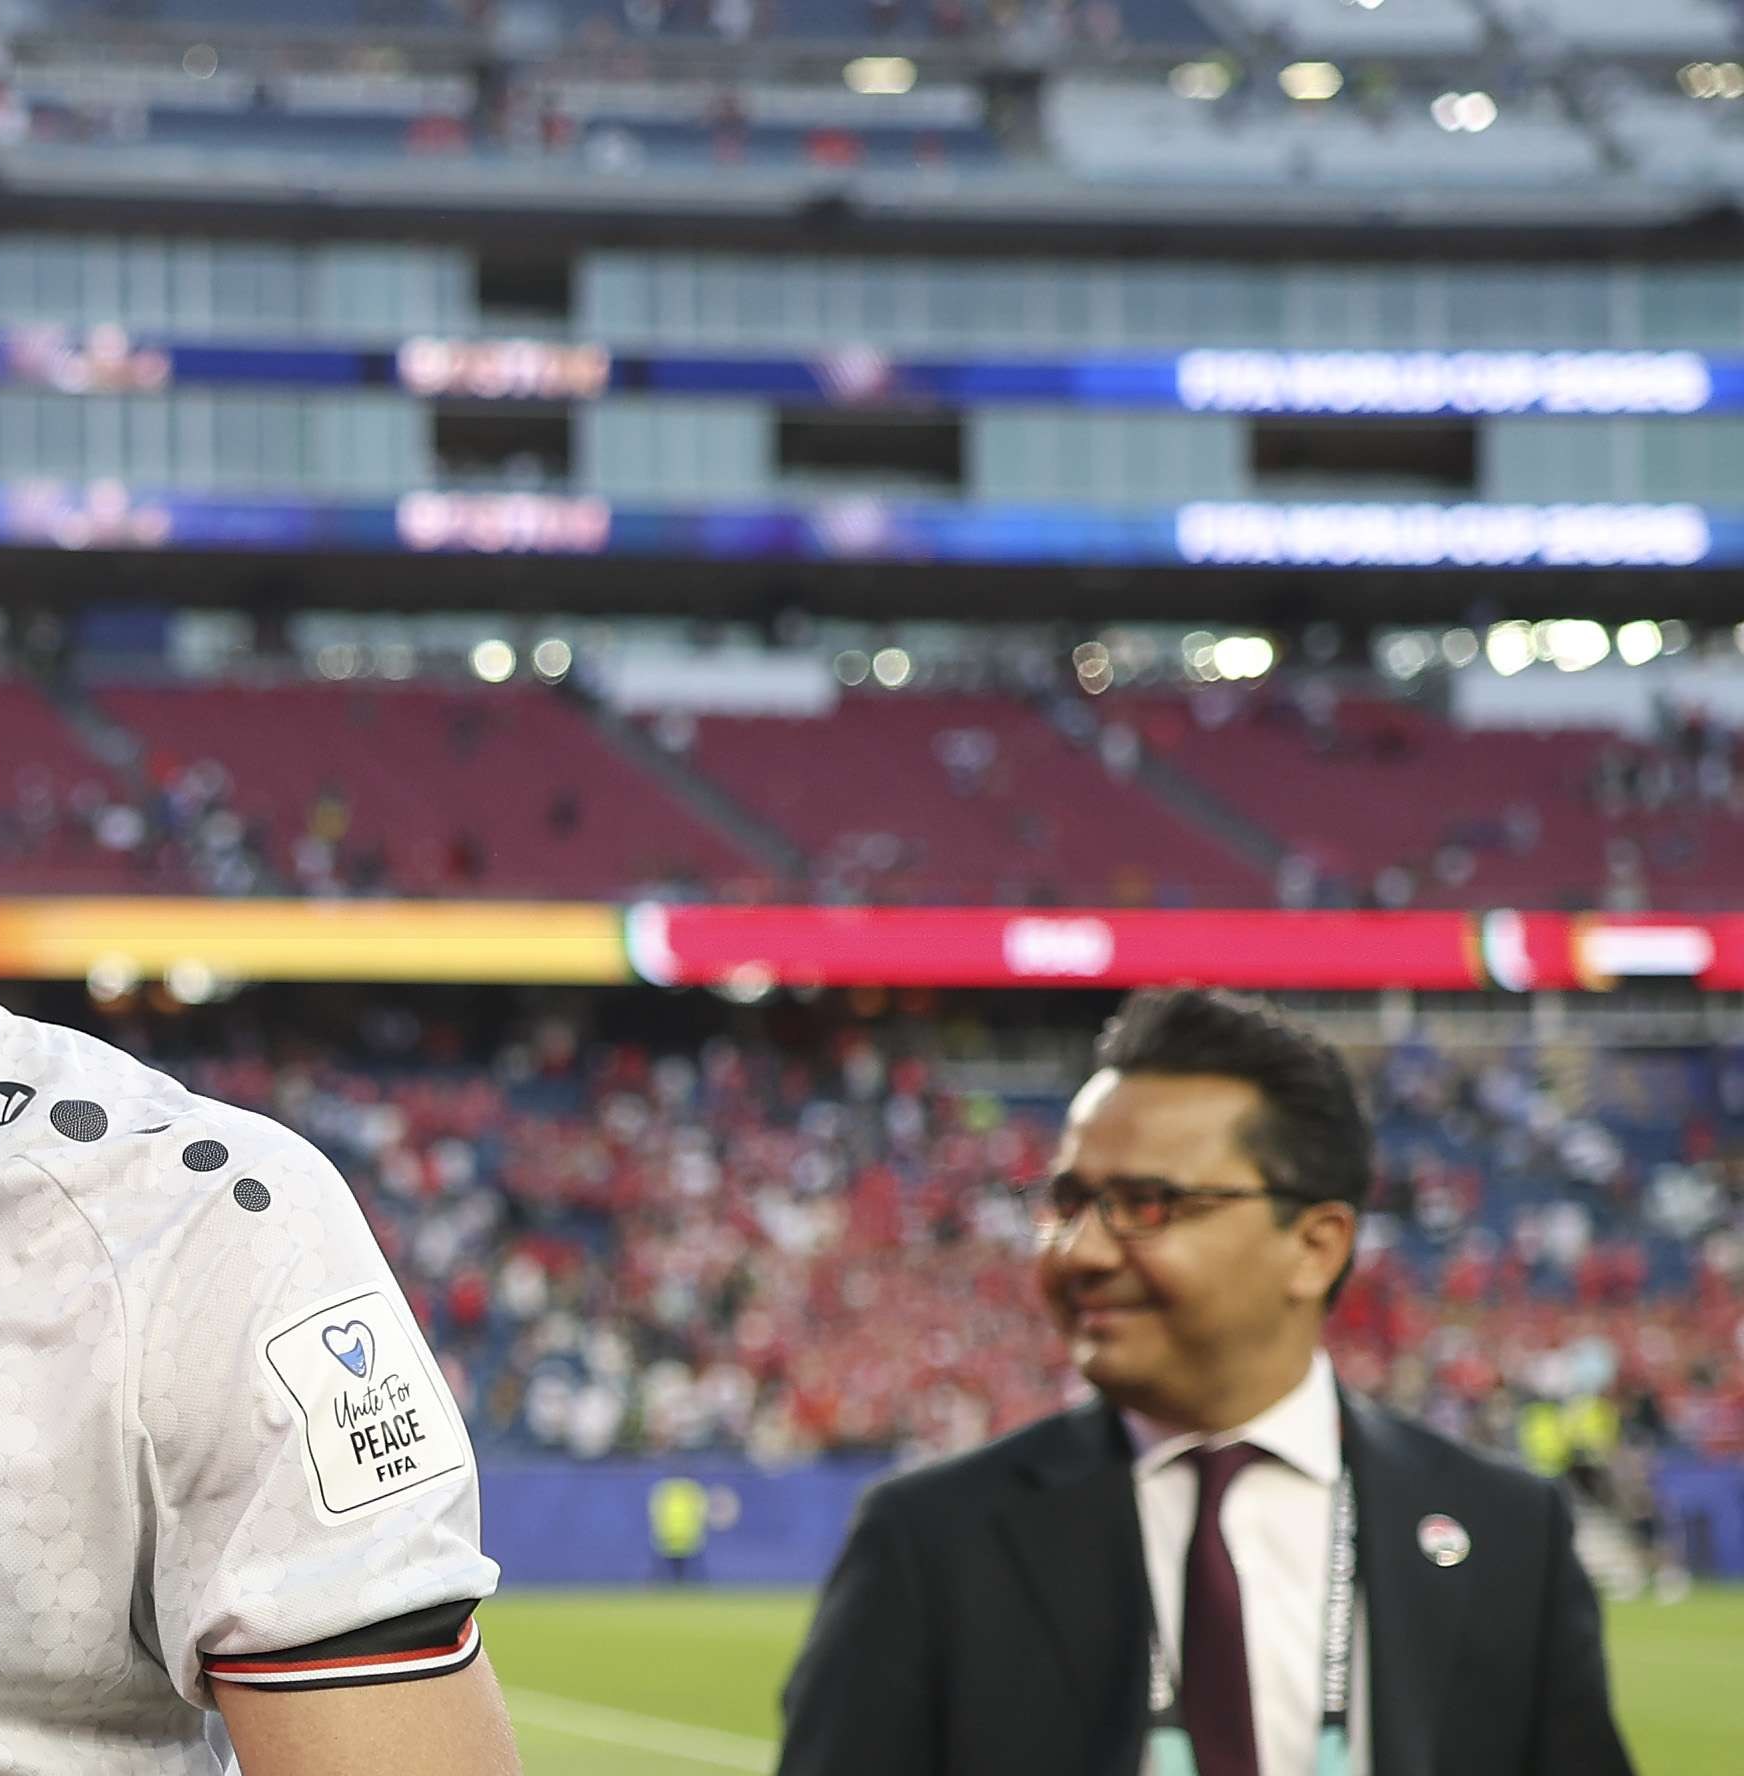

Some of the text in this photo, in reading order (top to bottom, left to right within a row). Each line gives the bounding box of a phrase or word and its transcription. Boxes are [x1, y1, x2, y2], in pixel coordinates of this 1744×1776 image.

[334, 1374, 410, 1429] Unite For
[350, 1409, 426, 1465] PEACE
[376, 1456, 417, 1483] FIFA
